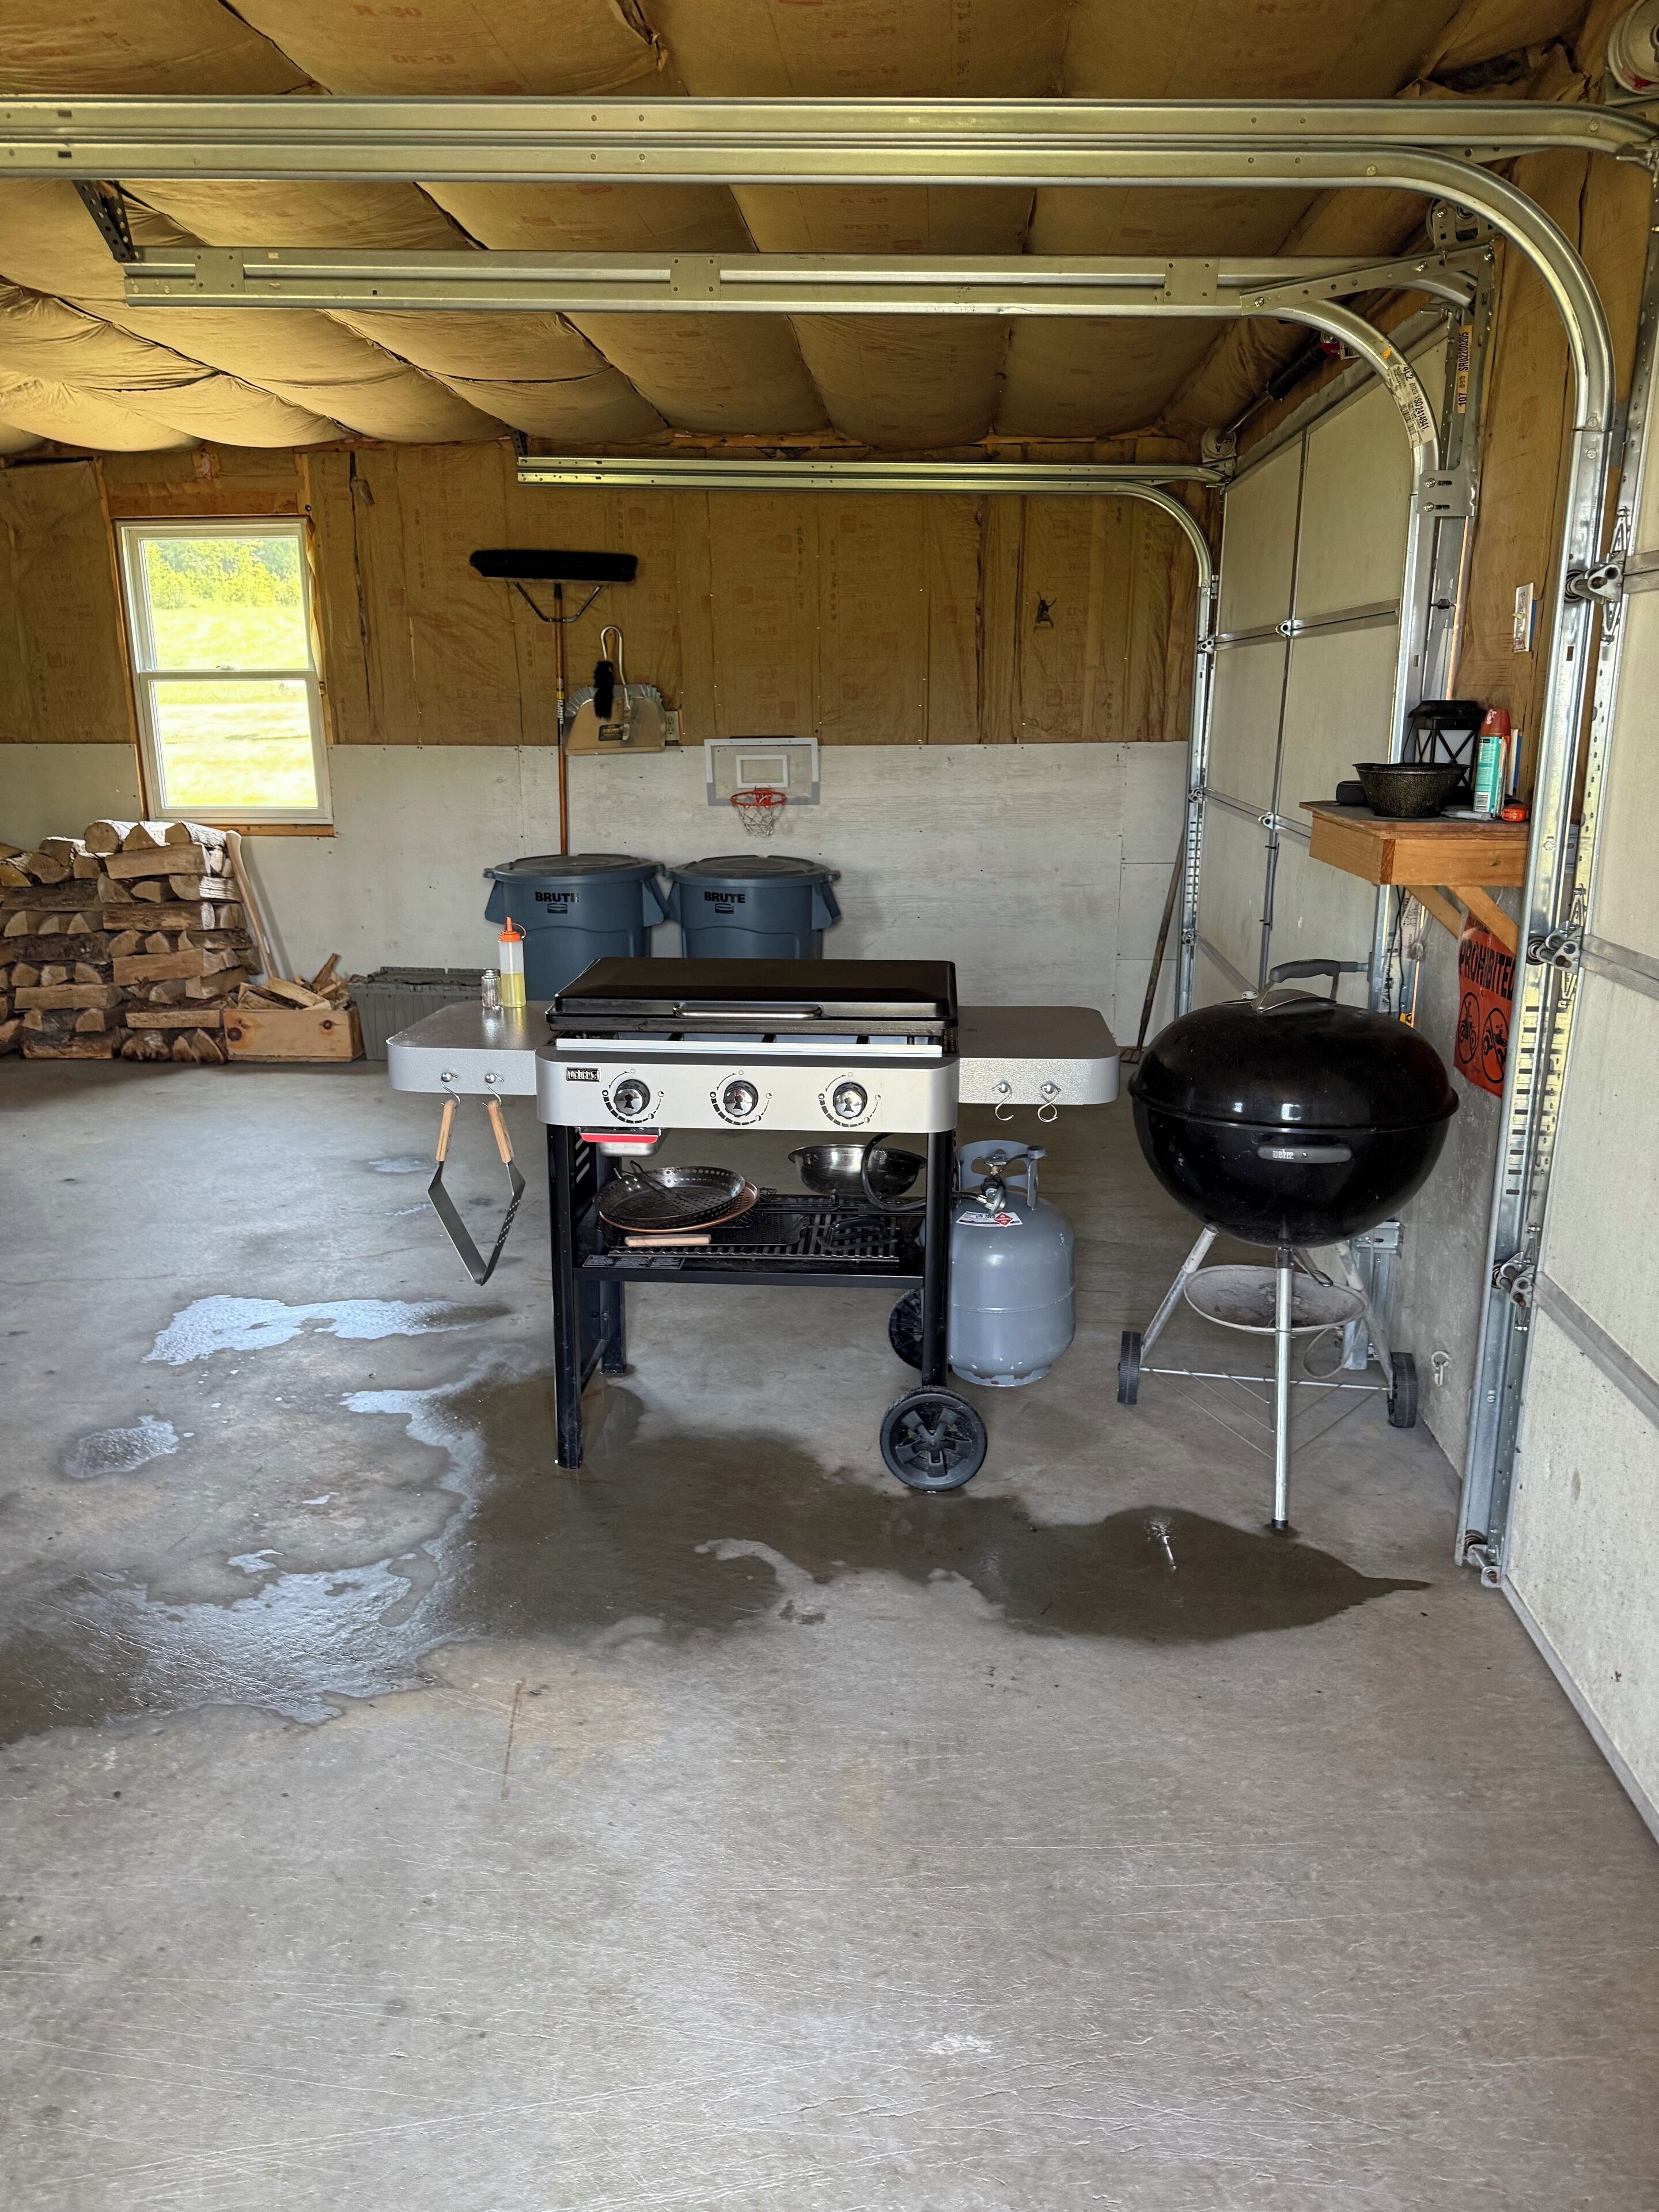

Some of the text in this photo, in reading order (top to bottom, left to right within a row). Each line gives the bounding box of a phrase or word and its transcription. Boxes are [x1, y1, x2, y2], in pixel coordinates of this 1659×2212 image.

[1459, 332, 1469, 372] SR02200205
[1403, 366, 1414, 381] 4L2
[1458, 392, 1467, 407] 107
[535, 892, 579, 903] BRUTE
[704, 891, 745, 903] BRUTE
